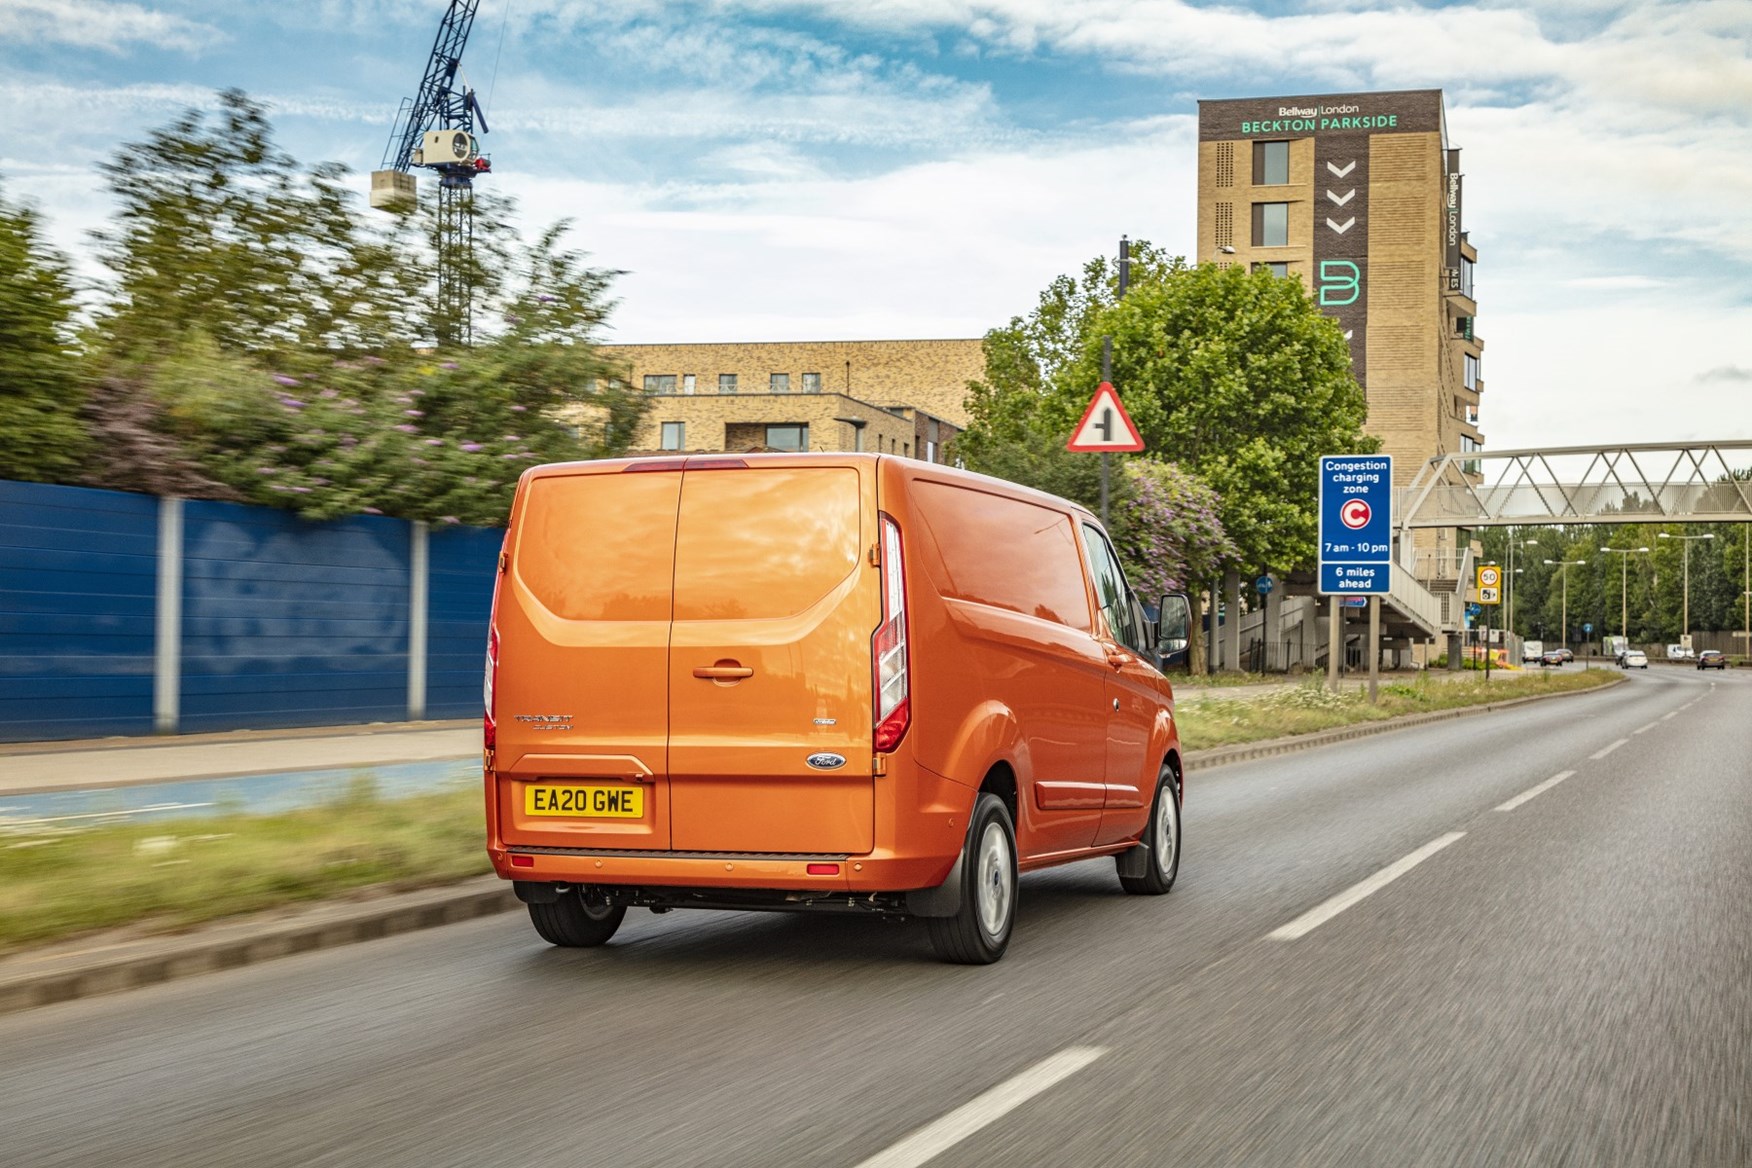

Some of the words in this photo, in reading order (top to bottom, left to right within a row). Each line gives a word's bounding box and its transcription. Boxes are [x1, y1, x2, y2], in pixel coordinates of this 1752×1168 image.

[1279, 106, 1317, 118] Bellway
[1321, 104, 1359, 115] London
[1242, 120, 1315, 133] BECKTON
[1321, 115, 1397, 129] PARKSIDE
[1446, 173, 1459, 208] Bellway
[1449, 210, 1459, 246] London
[1326, 460, 1387, 472] Congestion
[1333, 473, 1379, 483] charging
[1343, 485, 1369, 493] zone
[1358, 543, 1370, 552] 10
[1336, 567, 1343, 577] 6
[1346, 567, 1375, 577] miles
[1338, 579, 1371, 588] ahead
[815, 755, 837, 766] Ford
[534, 788, 587, 811] EA20
[593, 790, 633, 812] GWE
